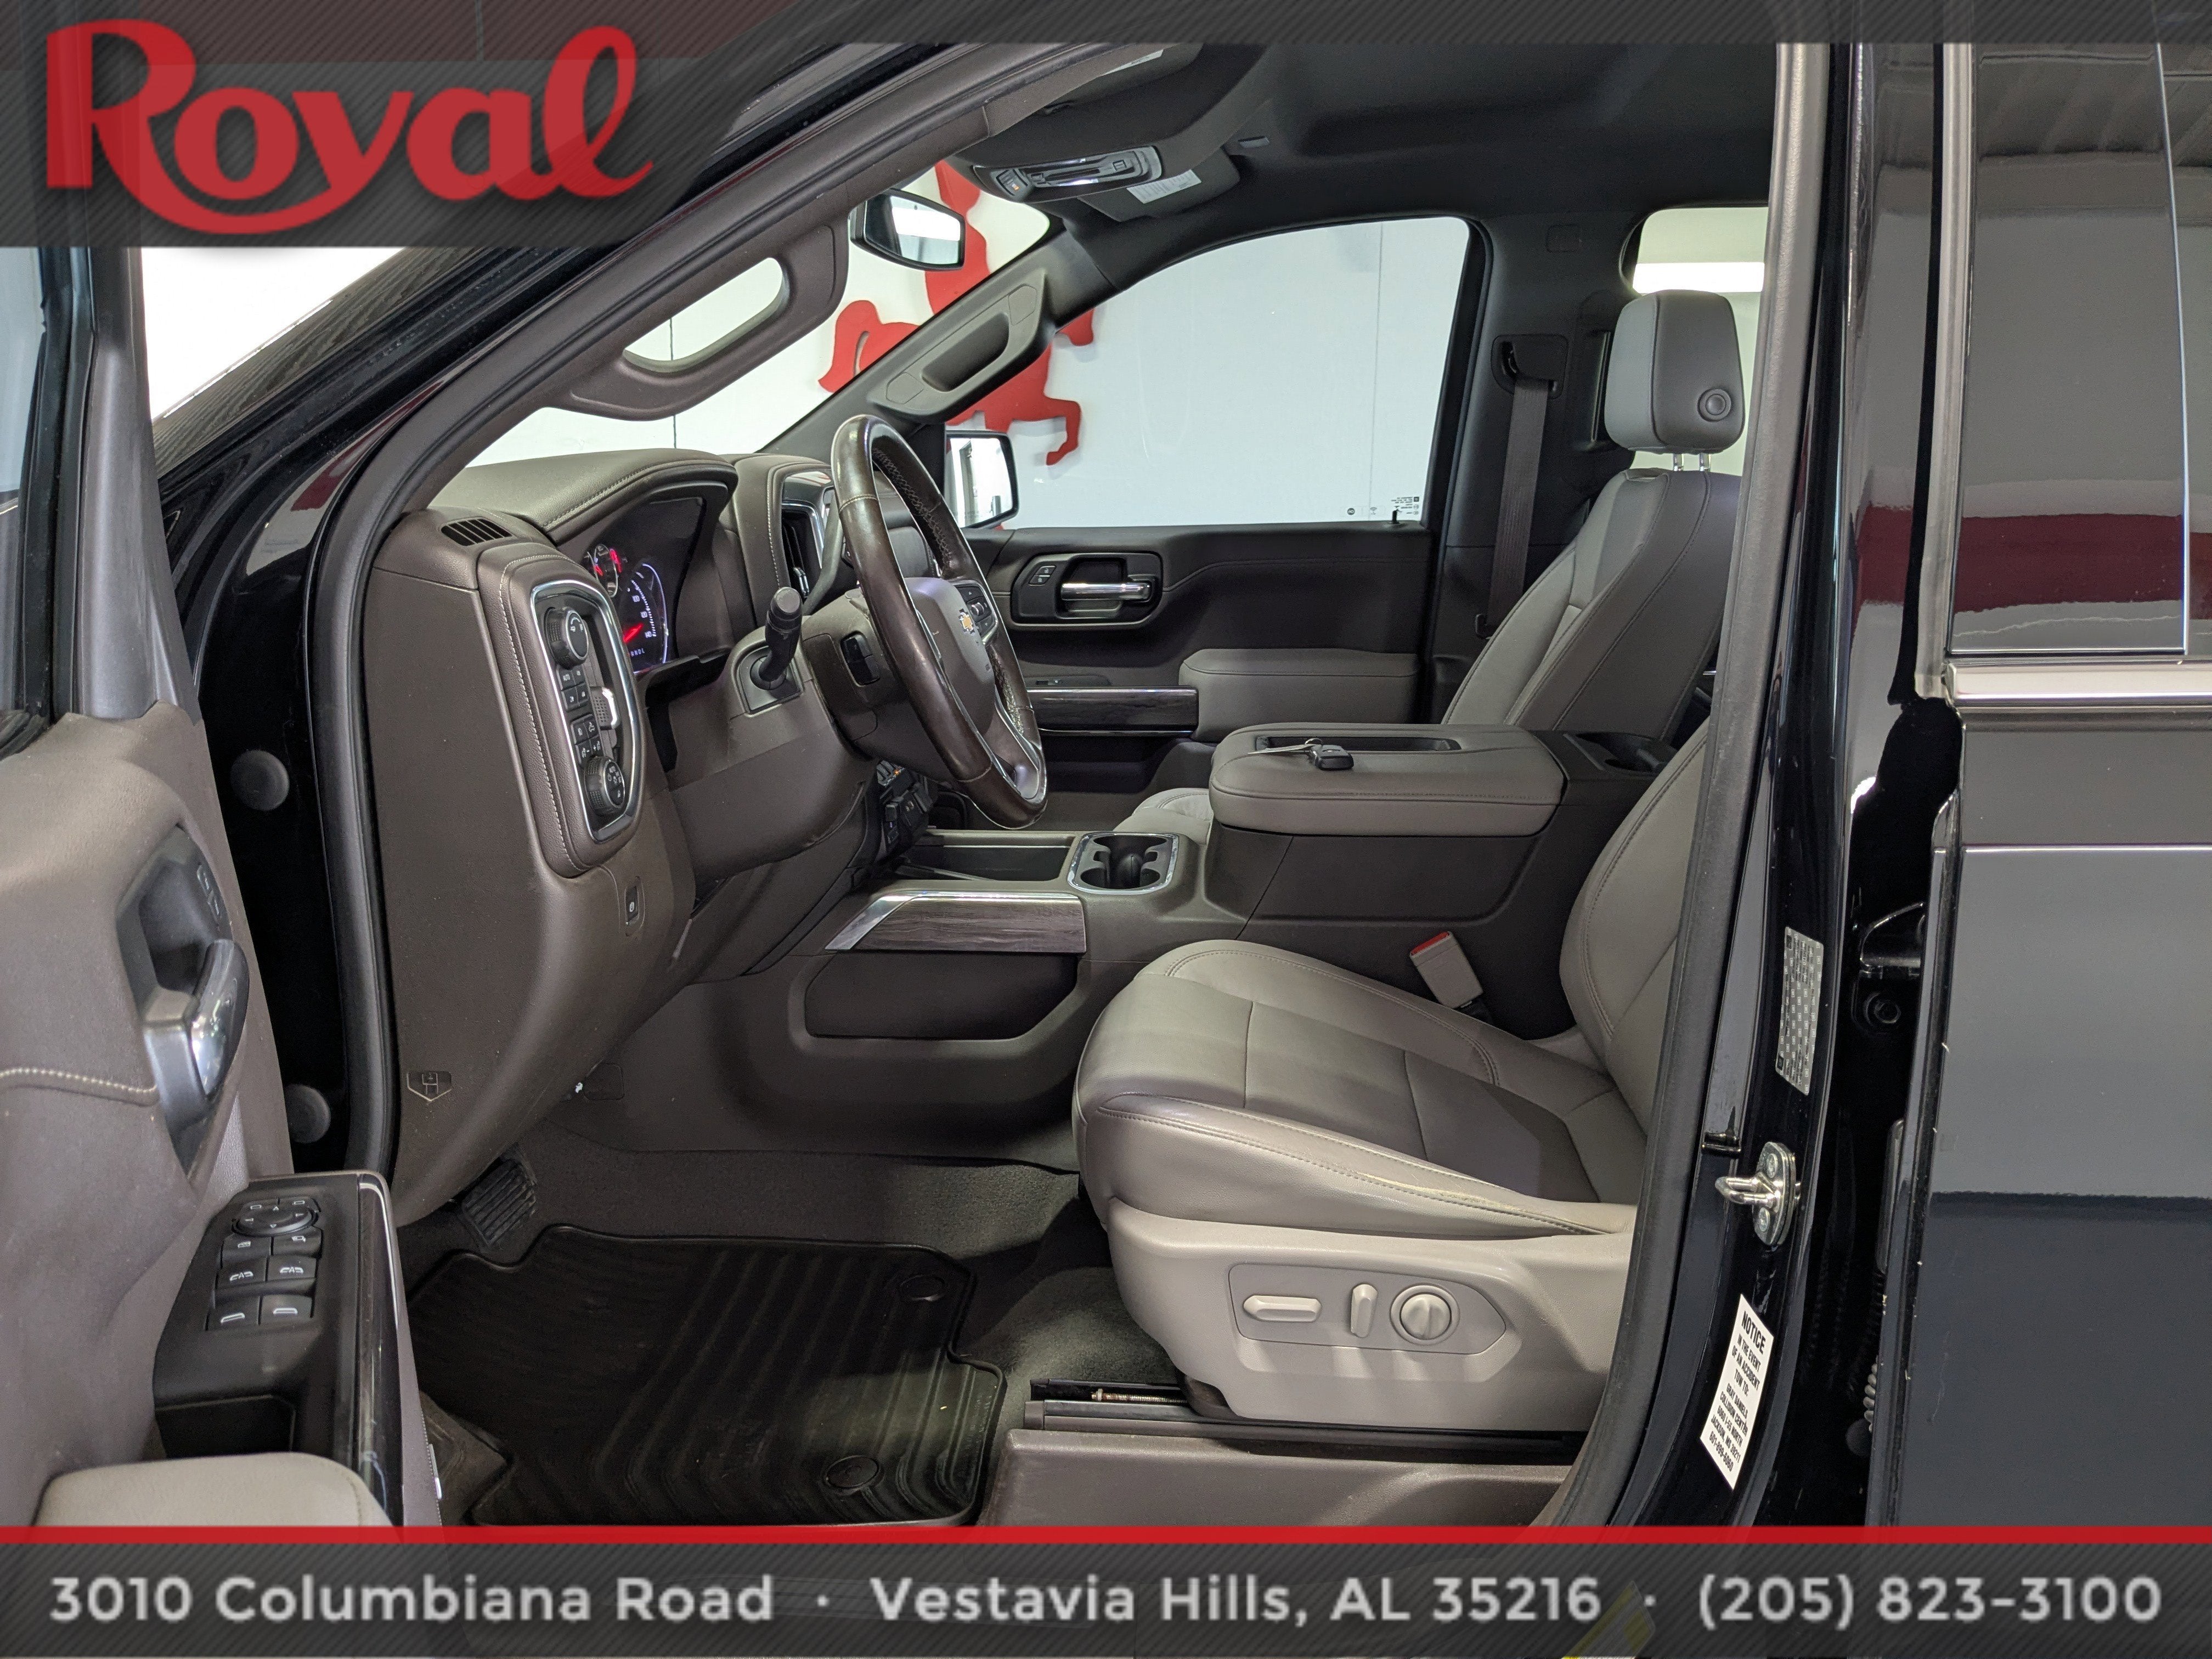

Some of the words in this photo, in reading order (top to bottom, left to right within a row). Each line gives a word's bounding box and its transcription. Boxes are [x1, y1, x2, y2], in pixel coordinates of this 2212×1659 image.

[1741, 1310, 1766, 1355] NOTICE
[1737, 1333, 1743, 1346] IN
[1748, 1348, 1761, 1372] EVENT
[1732, 1345, 1738, 1358] OF
[1736, 1352, 1743, 1367] AN
[1741, 1359, 1760, 1391] ACCIDENT
[1734, 1368, 1743, 1387] TOW
[1720, 1391, 1736, 1419] COLLISION
[1734, 1395, 1748, 1419] DANIELS
[1731, 1426, 1743, 1447] NORTH
